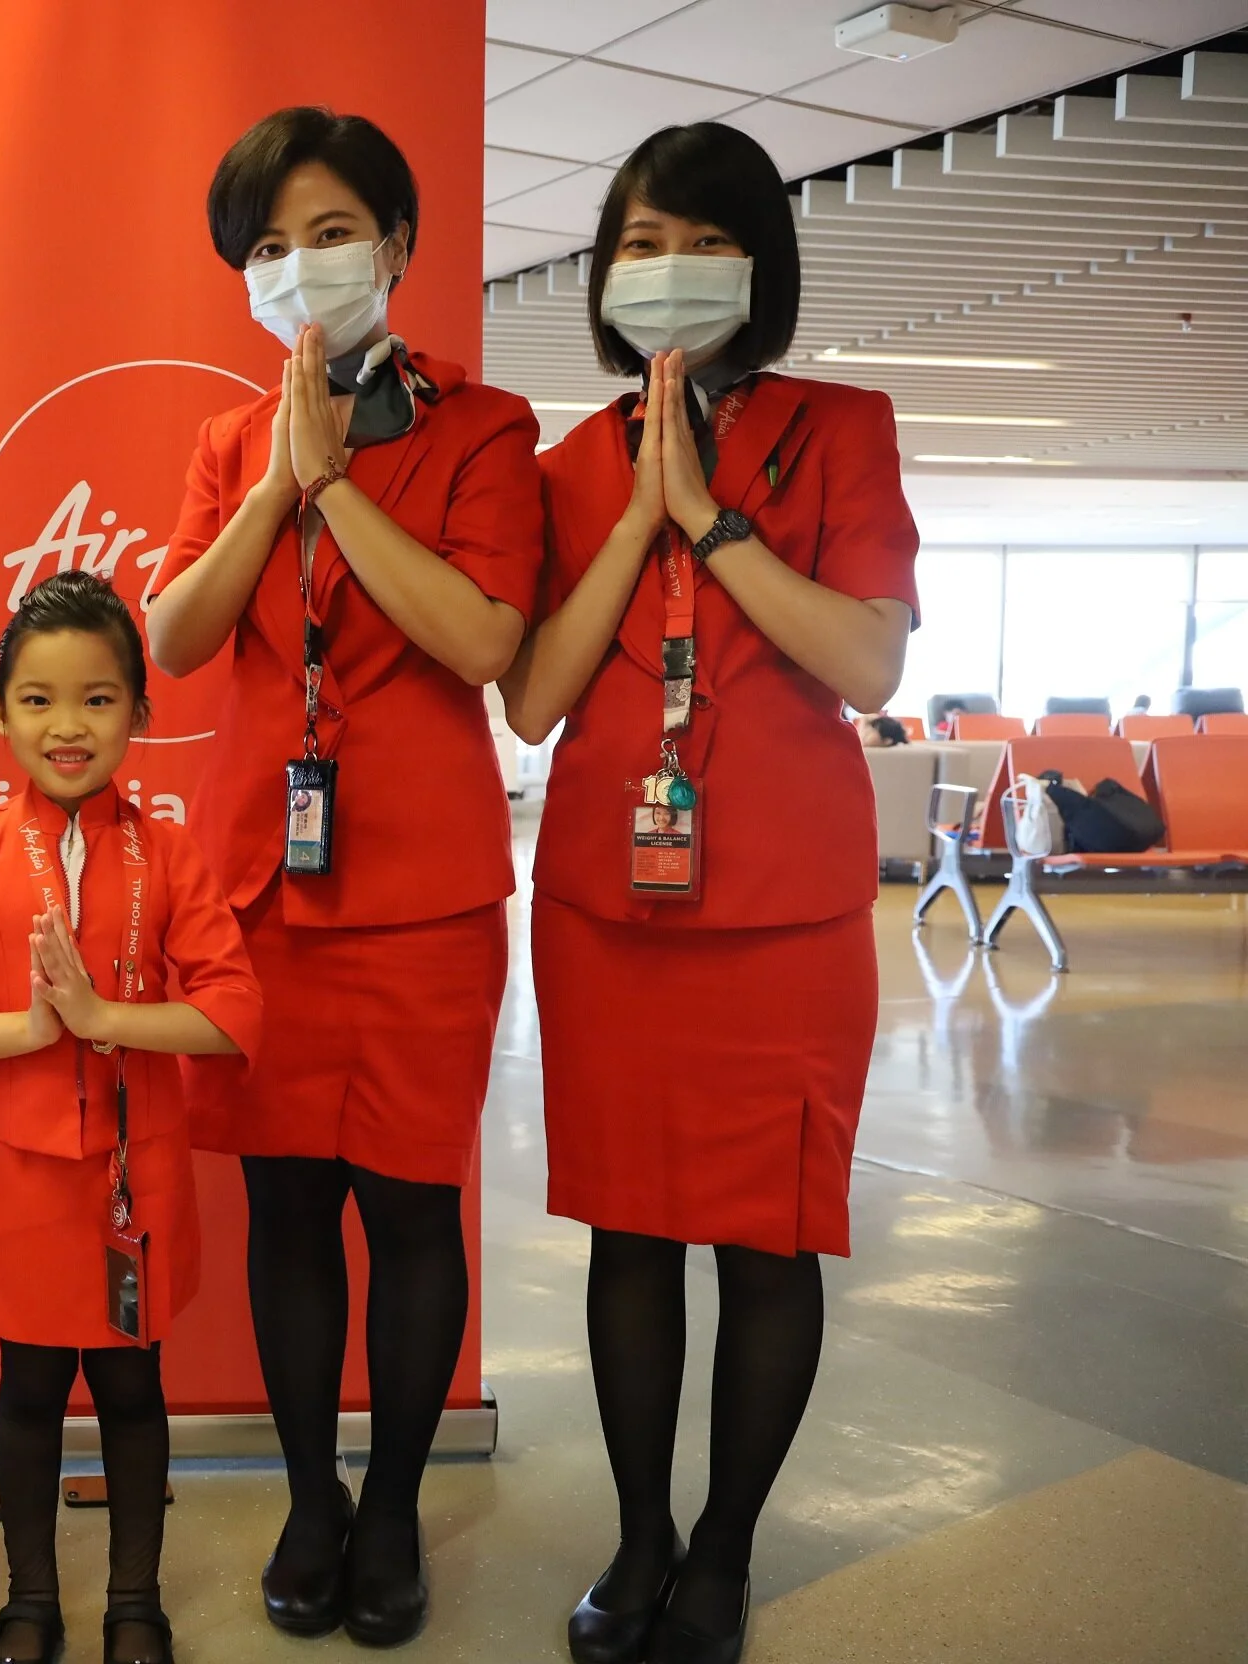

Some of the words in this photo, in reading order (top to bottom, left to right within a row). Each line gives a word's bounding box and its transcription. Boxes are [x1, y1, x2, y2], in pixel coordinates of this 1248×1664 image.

[667, 557, 677, 578] FOR
[672, 578, 682, 597] ALL
[132, 877, 142, 899] ALL
[131, 901, 141, 926] FOR
[128, 929, 139, 954] ONE
[124, 972, 134, 998] ONE
